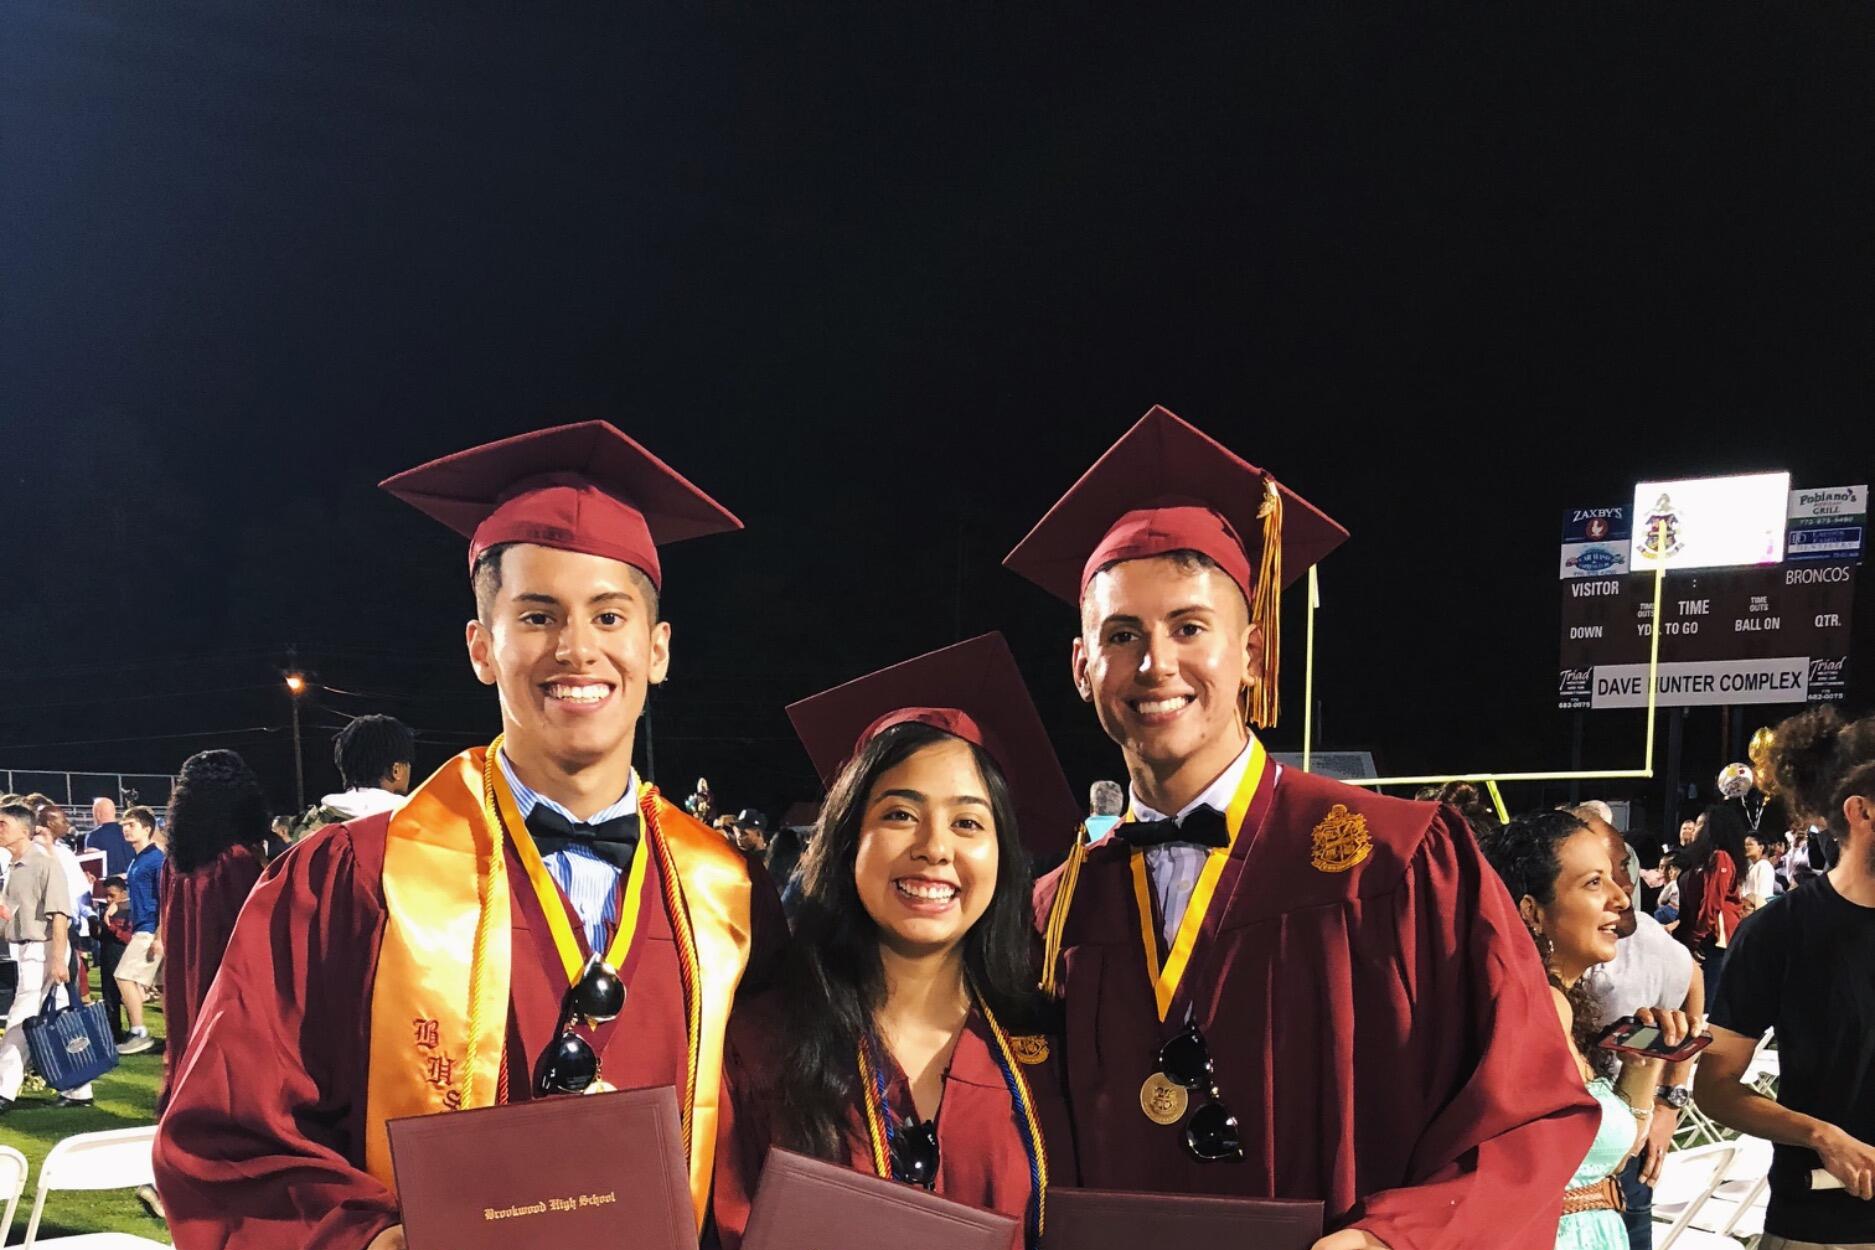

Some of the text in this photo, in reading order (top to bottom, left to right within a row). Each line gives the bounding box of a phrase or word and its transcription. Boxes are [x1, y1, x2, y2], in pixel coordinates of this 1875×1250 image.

[1800, 488, 1856, 505] Poblano's
[1573, 507, 1623, 522] ZAXBY'S
[1813, 506, 1841, 515] GRILL
[1786, 566, 1850, 584] BRONCOS
[1571, 581, 1619, 597] VISITOR
[1678, 599, 1710, 615] TIME
[1751, 596, 1767, 604] TIME
[1749, 604, 1768, 612] OUTS
[1735, 617, 1780, 632] BALL ON
[1815, 614, 1842, 627] QTR.
[1570, 626, 1602, 639] DOWN
[1637, 621, 1698, 636] YD. TO GO
[1809, 656, 1847, 681] Triad
[1560, 667, 1593, 690] Triad
[1598, 677, 1641, 695] DAVE
[1720, 672, 1802, 691] COMPLEX
[484, 1191, 616, 1220] Brookwood High School
